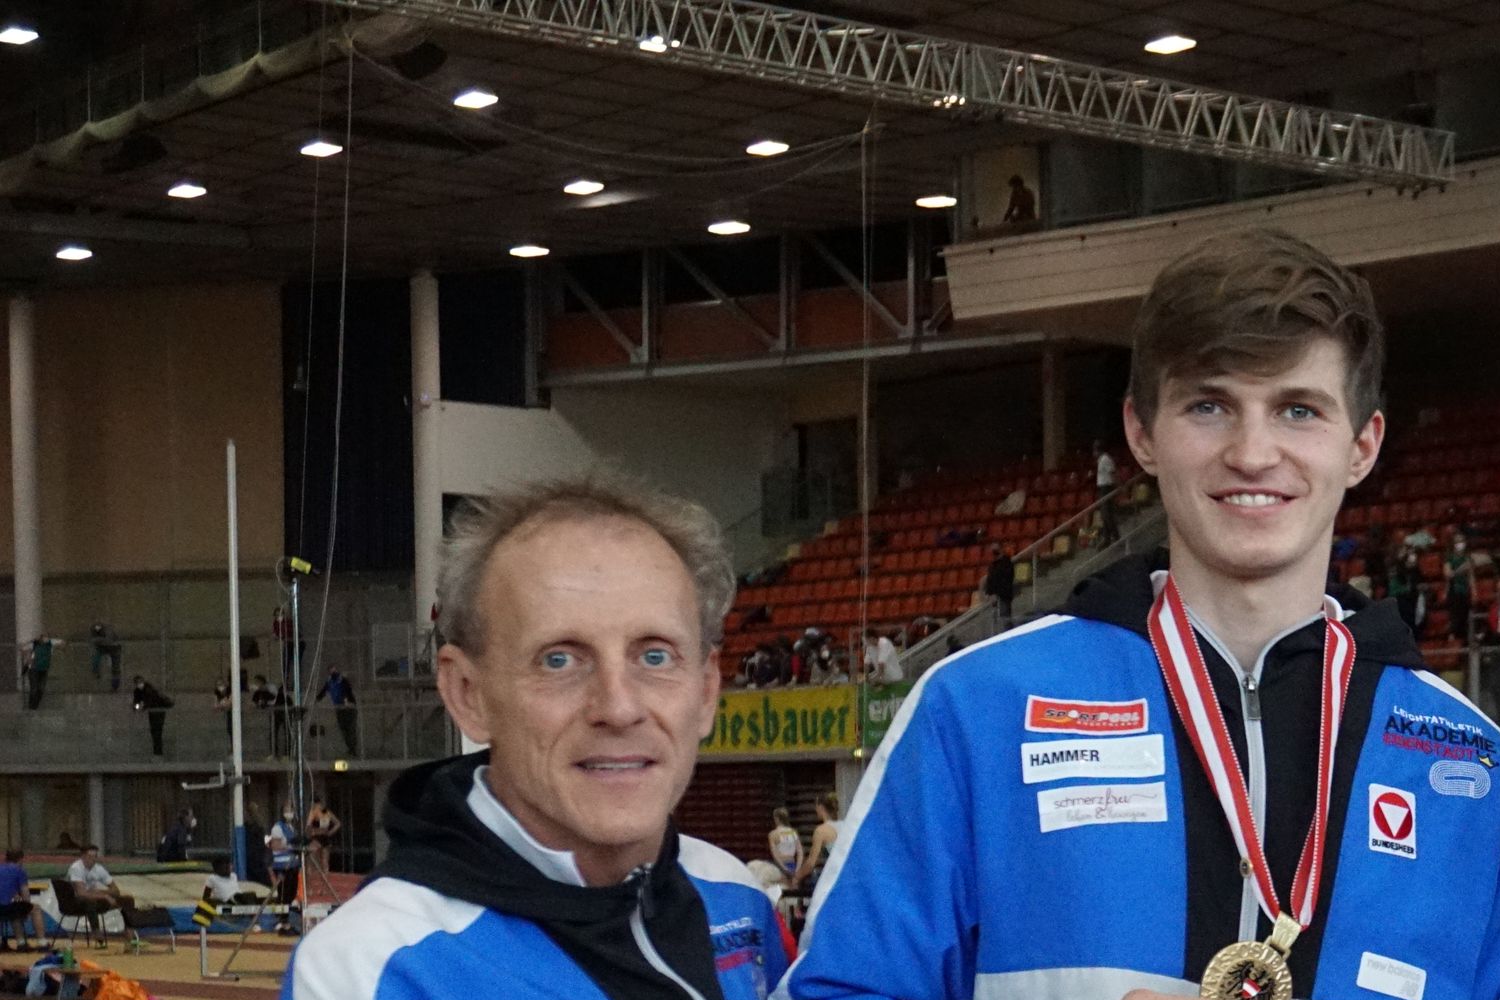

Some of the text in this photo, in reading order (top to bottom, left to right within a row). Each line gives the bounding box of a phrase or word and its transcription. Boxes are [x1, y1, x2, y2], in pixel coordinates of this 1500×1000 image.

[701, 696, 849, 748] iesbauer
[1383, 715, 1498, 754] AKADEMIE
[1393, 705, 1483, 735] LEICHTATHLETIK
[1029, 749, 1100, 767] HAMMER
[1382, 732, 1474, 761] EISENSTADT
[1371, 838, 1415, 855] BUNDESHEER
